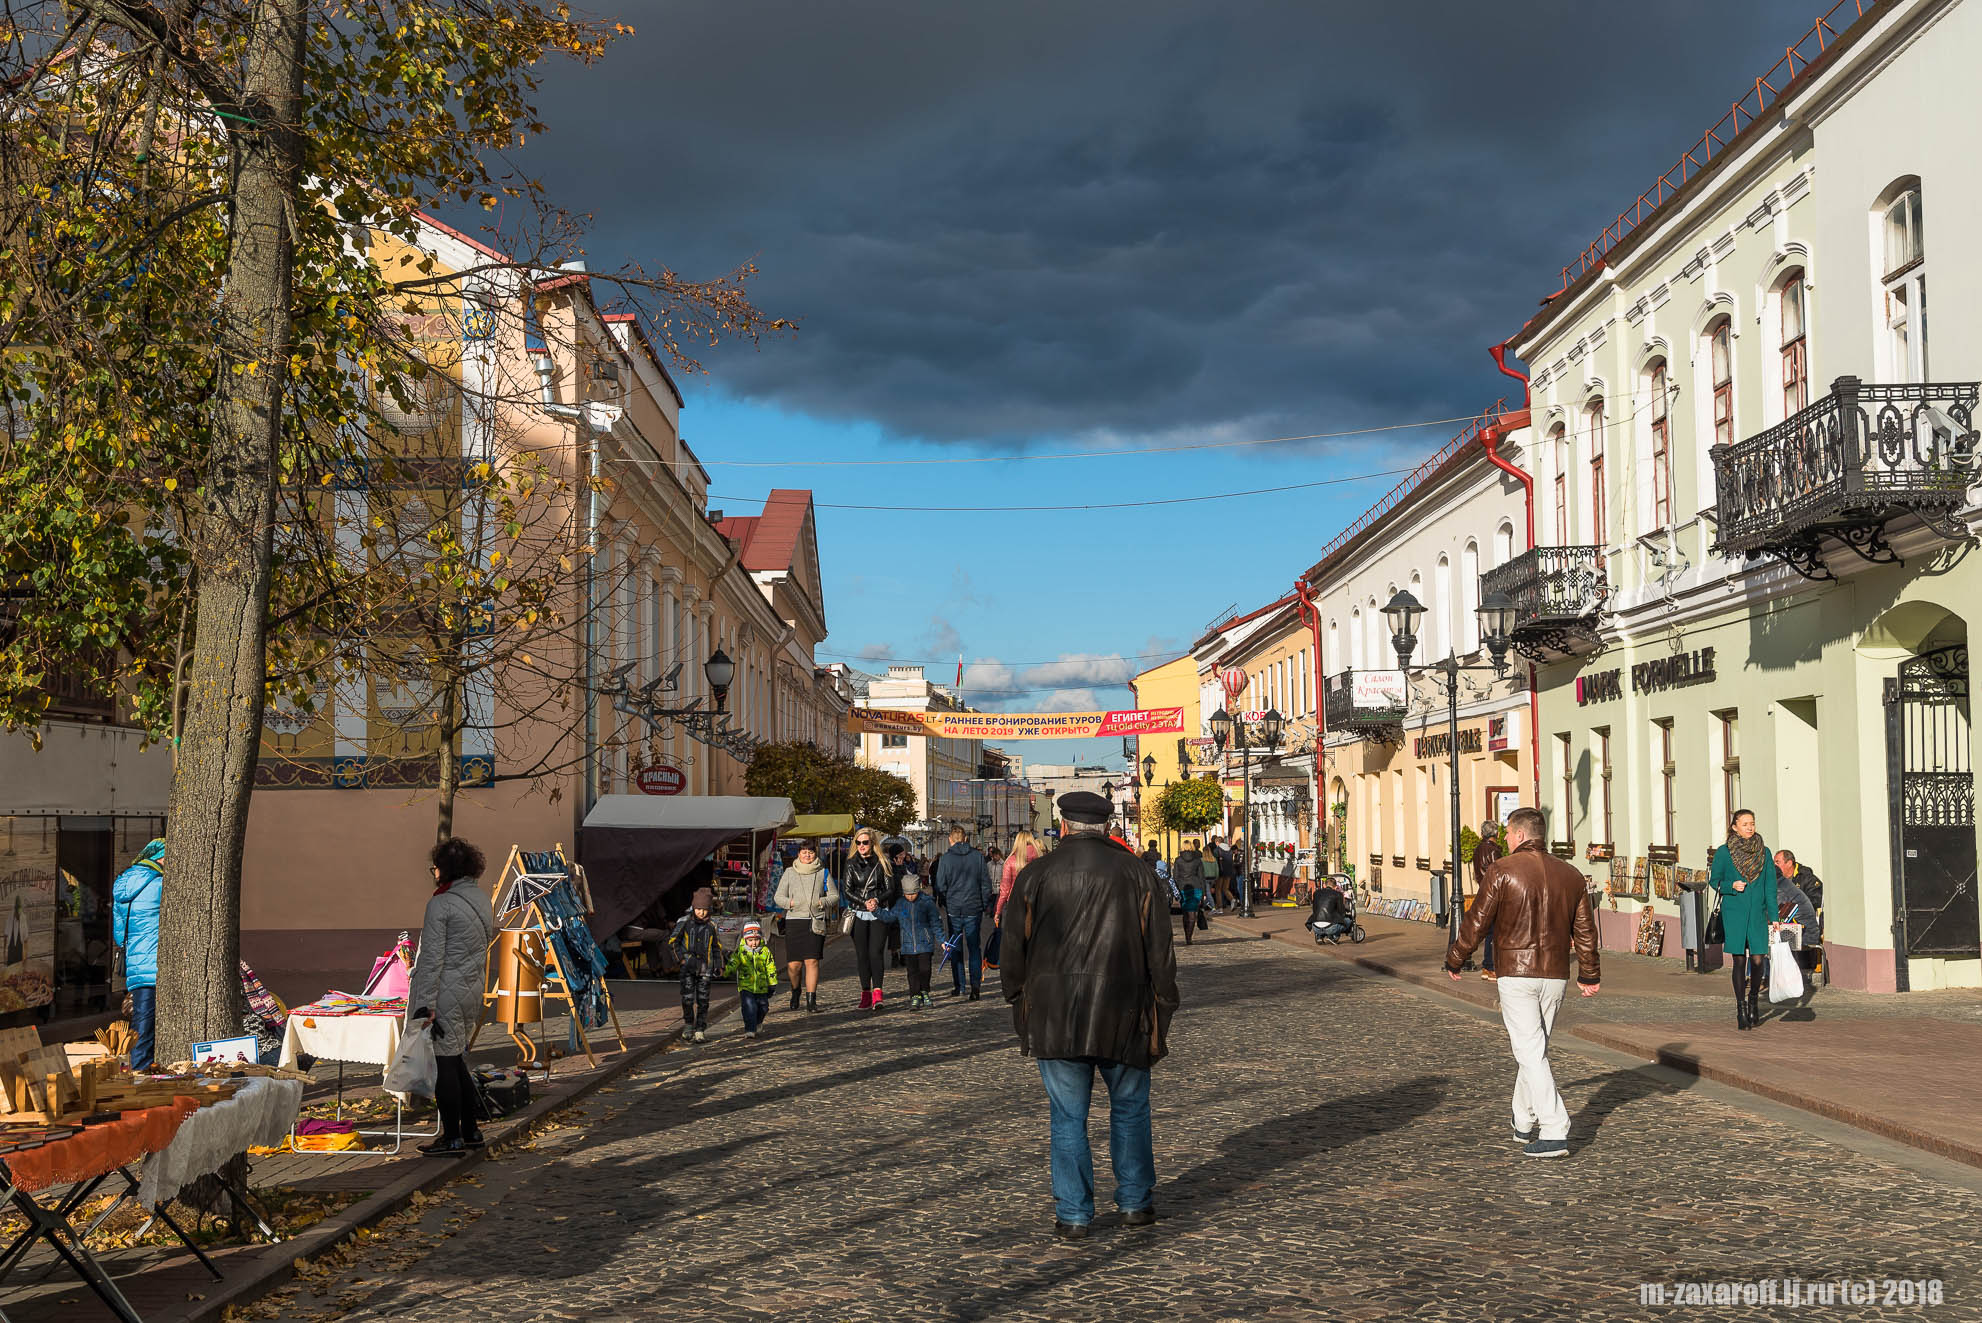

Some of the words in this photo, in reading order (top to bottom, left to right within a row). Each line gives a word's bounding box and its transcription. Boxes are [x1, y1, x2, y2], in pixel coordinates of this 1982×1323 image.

[1576, 668, 1622, 706] MARK
[1631, 646, 1716, 696] FORMELLE
[850, 709, 937, 724] NOVATURAS.LT
[944, 716, 983, 725] РАННЕЕ
[985, 716, 1067, 725] БРОНИРОВАНИЕ
[1067, 715, 1102, 724] ТУРОВ
[1111, 712, 1149, 722] ЕГИПЕТ
[944, 726, 959, 735] НА
[962, 727, 989, 735] ЛЕТО
[990, 728, 1014, 736] 2019
[1018, 727, 1040, 736] УЖЕ
[1041, 726, 1090, 735] ОТКРЫТО
[1106, 724, 1118, 732] ТЦ
[1118, 722, 1133, 730] Old
[1134, 722, 1150, 730] City
[1151, 721, 1157, 729] 2
[643, 770, 679, 785] КРАСНЫЙ
